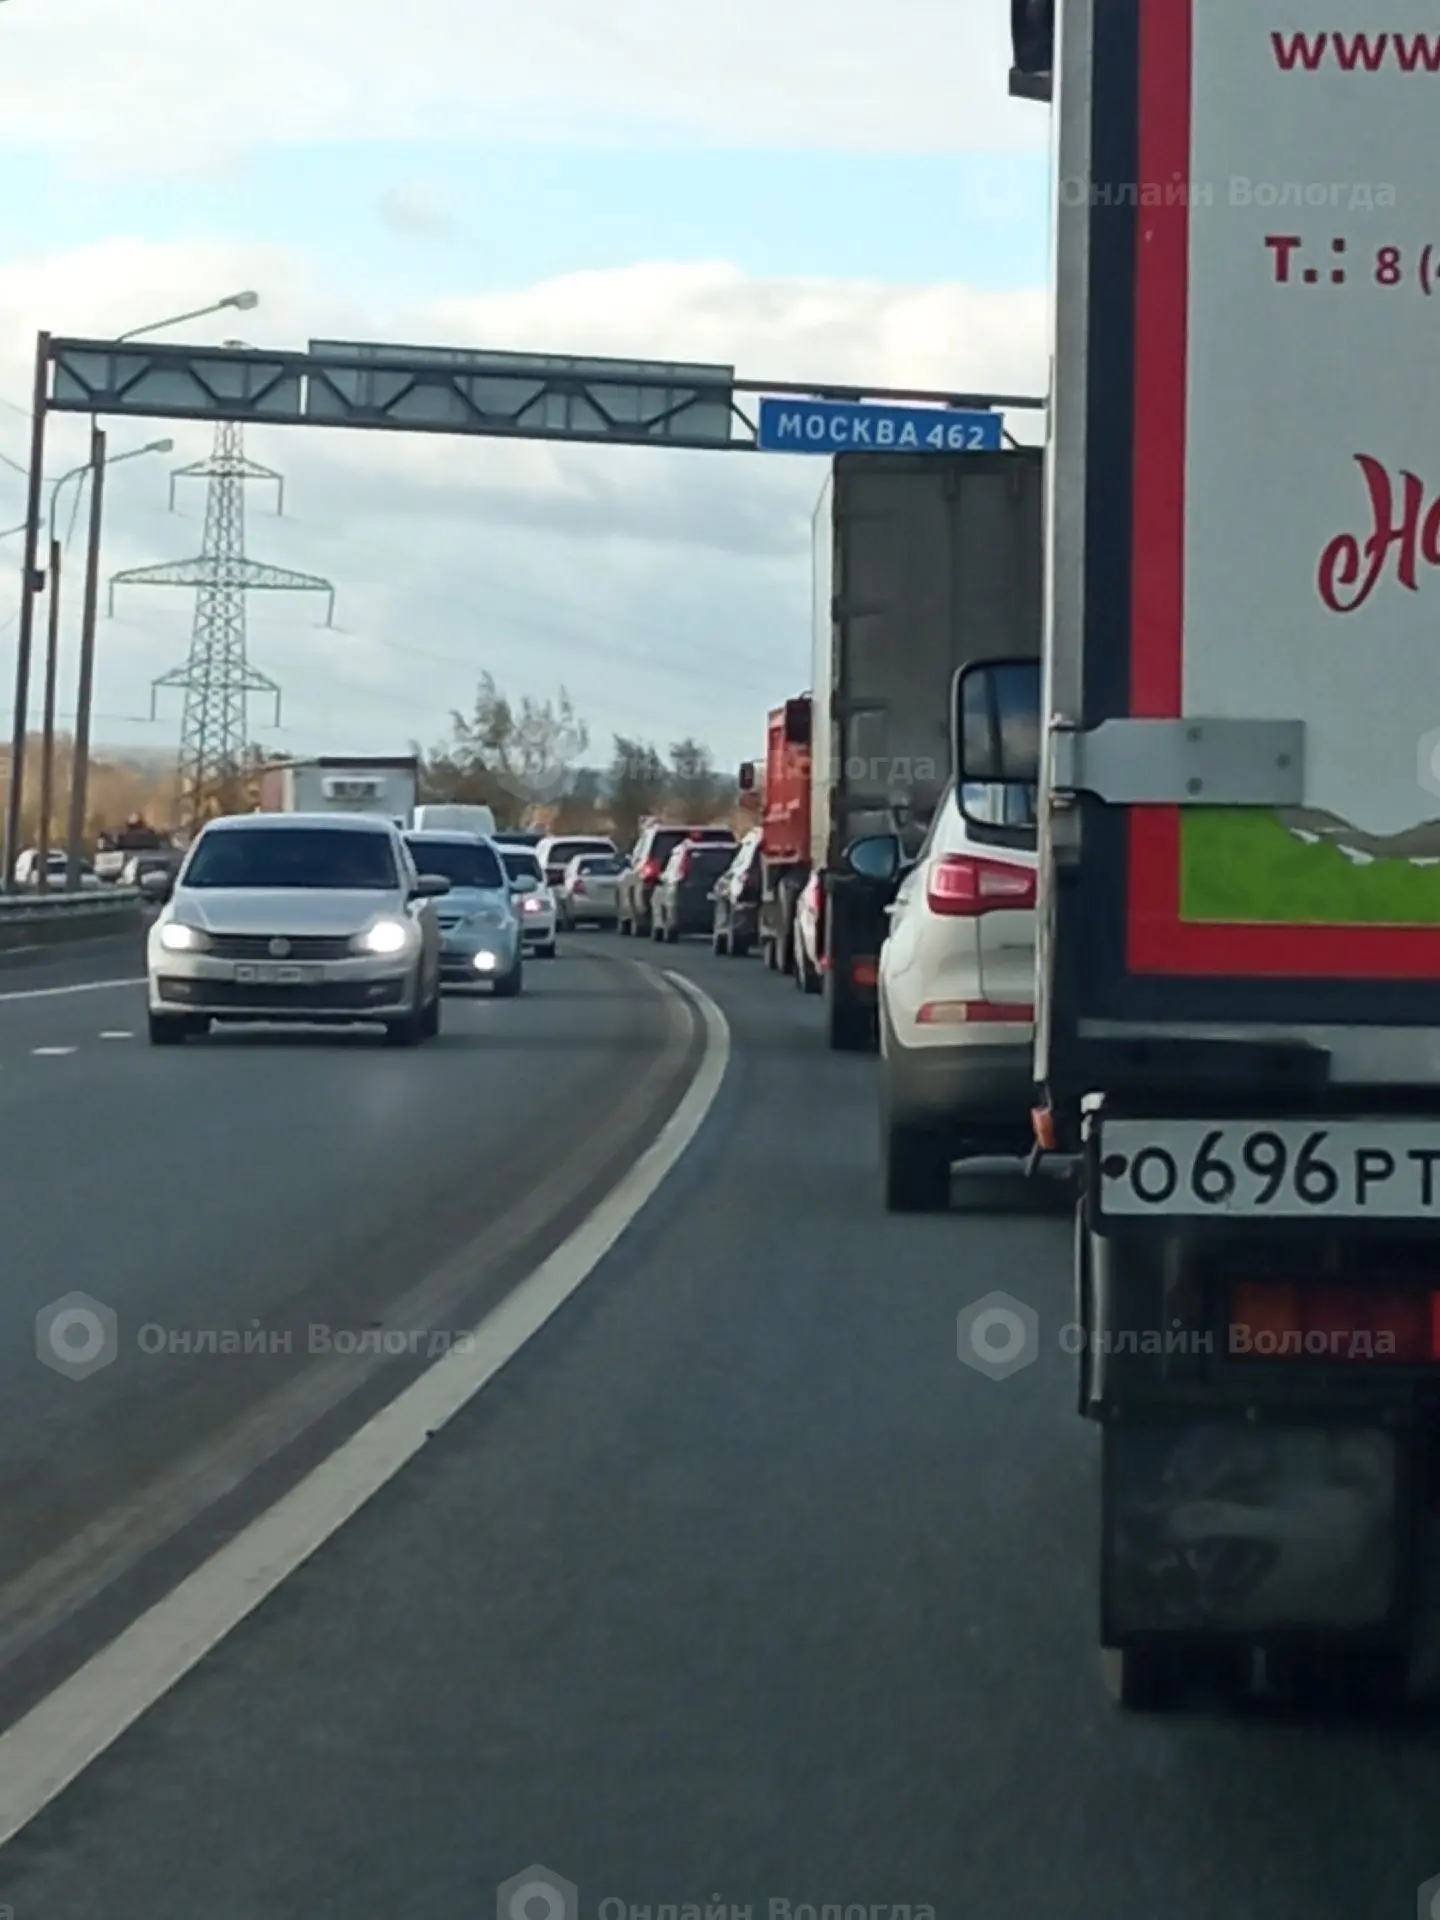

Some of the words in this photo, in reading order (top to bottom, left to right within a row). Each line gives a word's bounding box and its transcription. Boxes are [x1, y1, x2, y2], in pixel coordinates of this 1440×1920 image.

[1376, 246, 1401, 286] 8
[777, 413, 919, 447] МОСКВА
[926, 424, 985, 450] 462
